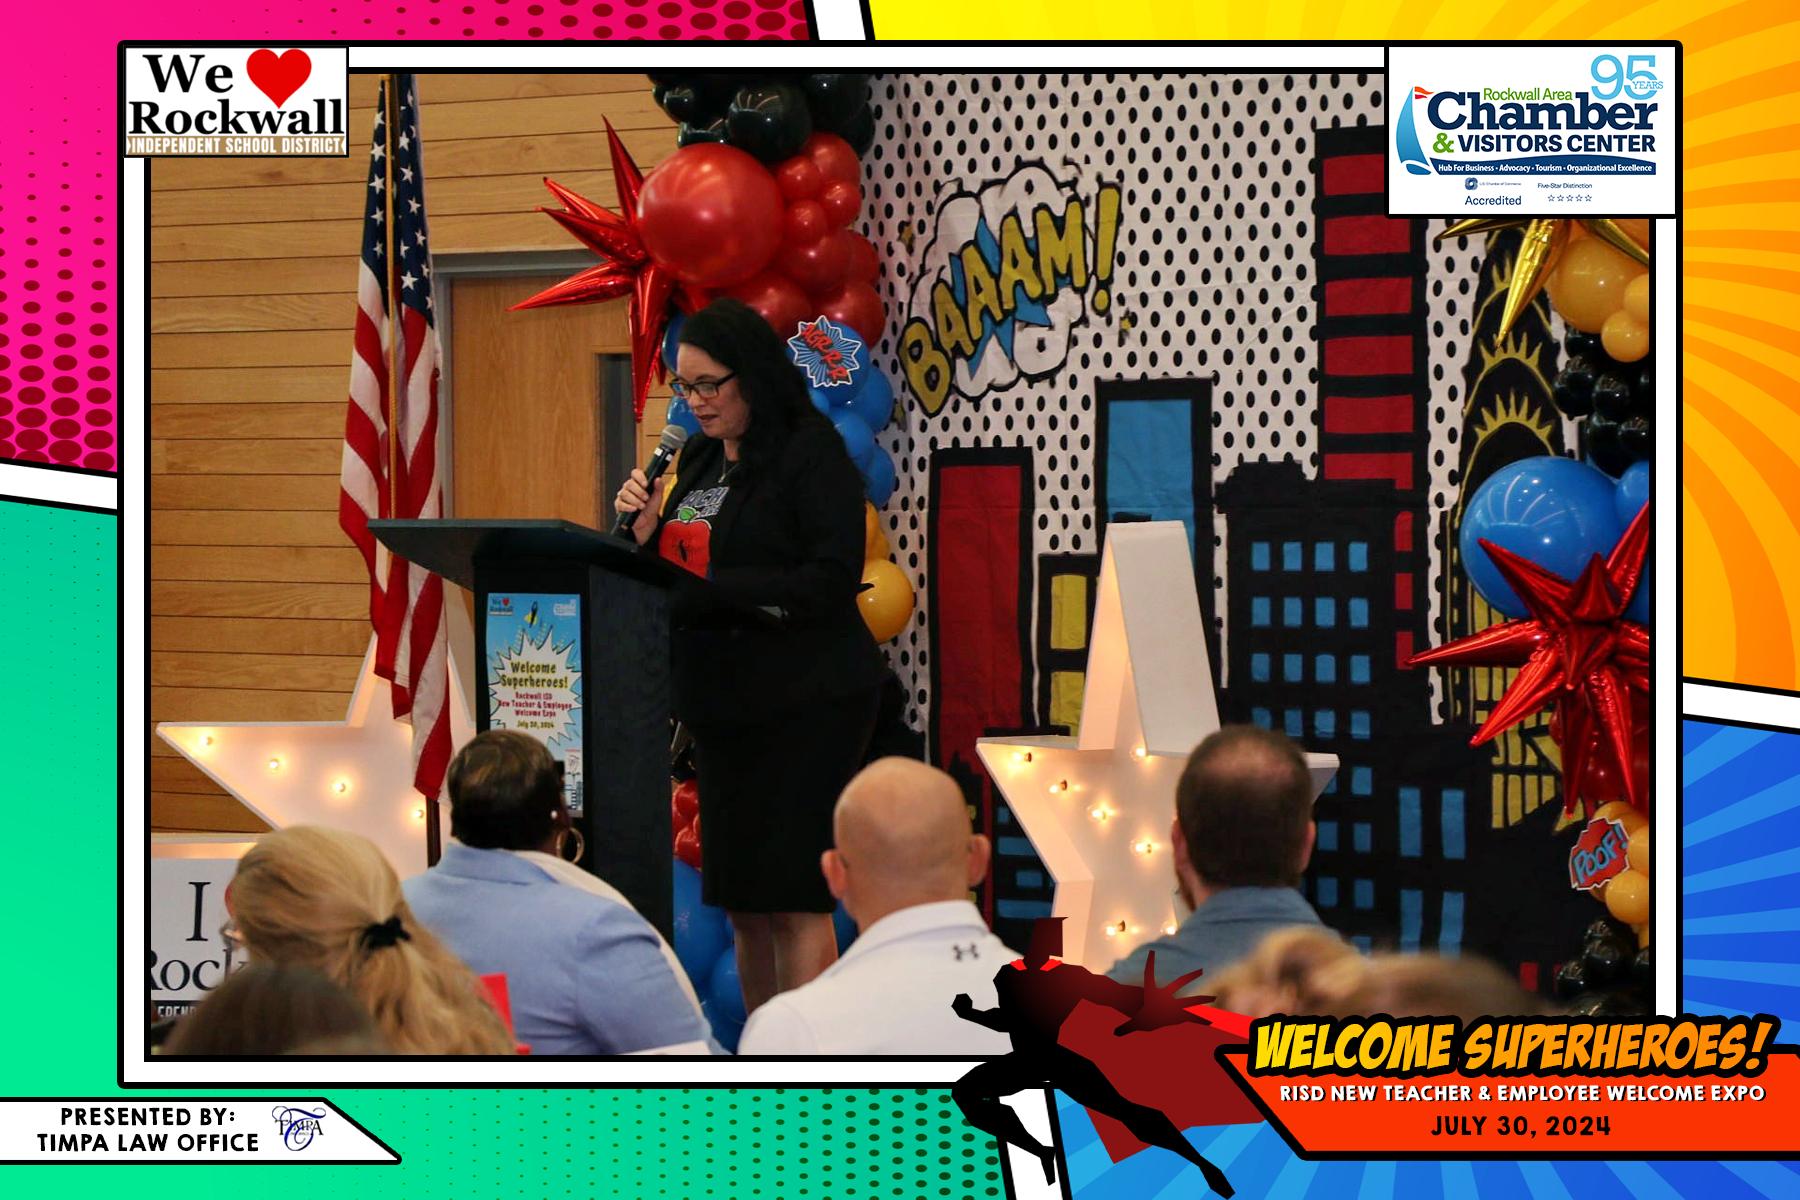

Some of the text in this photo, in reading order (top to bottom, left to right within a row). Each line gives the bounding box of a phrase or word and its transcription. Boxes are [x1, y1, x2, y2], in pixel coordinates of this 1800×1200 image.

[898, 183, 1122, 418] BAAAM!
[500, 674, 568, 690] Superheroes!
[510, 661, 557, 673] Welcome
[1573, 823, 1627, 884] POOF!
[185, 881, 212, 942] I
